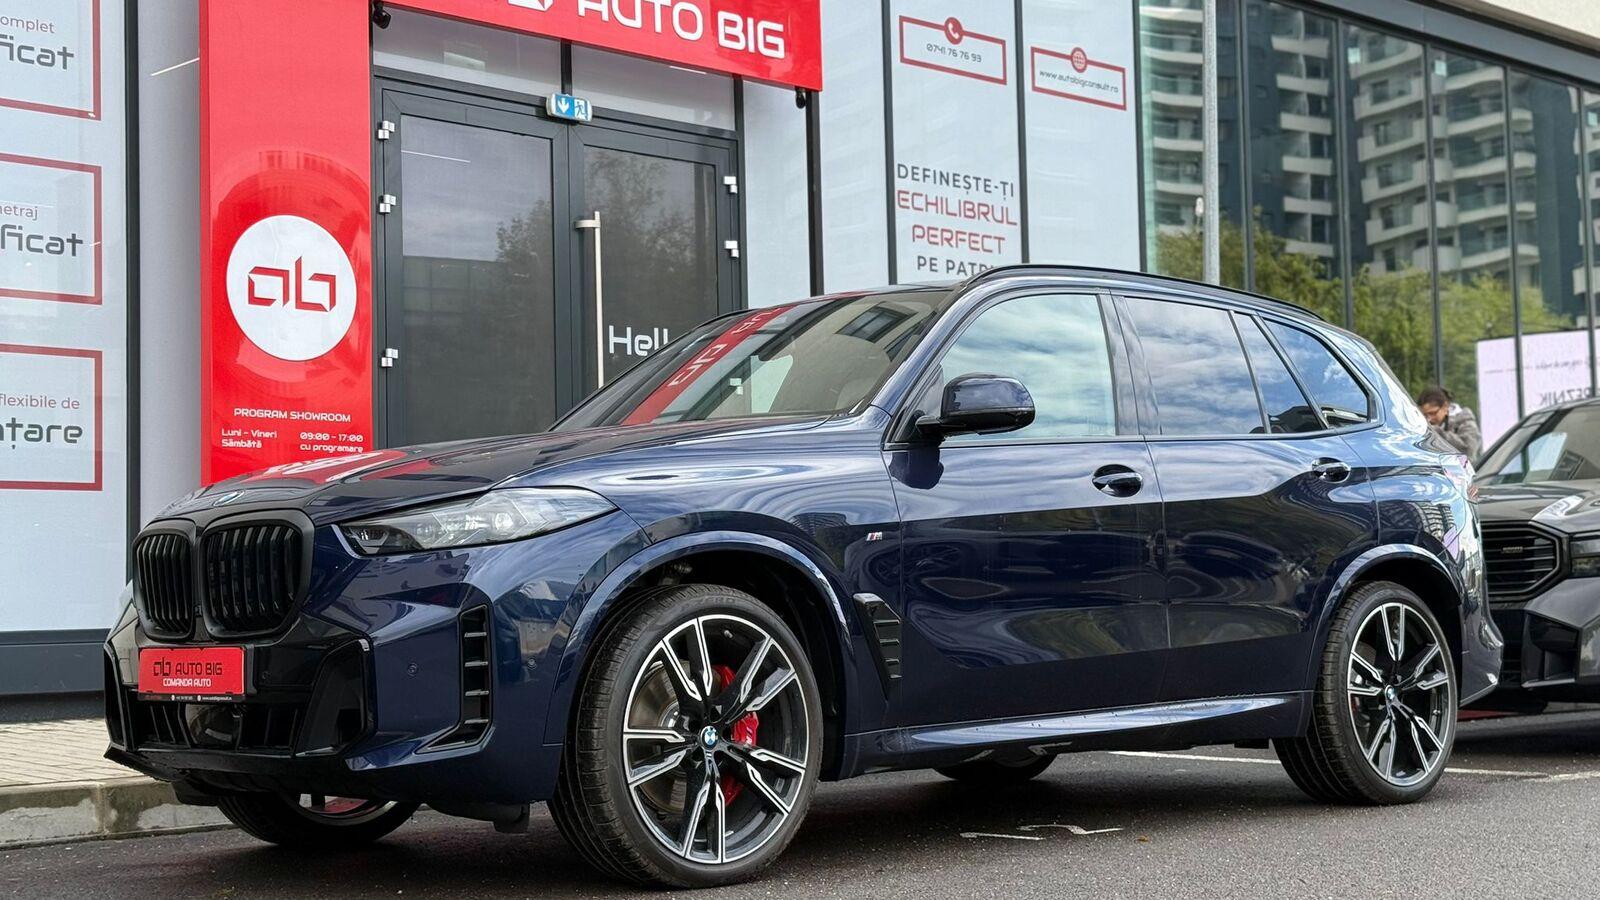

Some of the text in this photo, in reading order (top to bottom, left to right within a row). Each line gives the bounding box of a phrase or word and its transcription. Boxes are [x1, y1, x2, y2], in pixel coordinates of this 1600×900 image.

[717, 11, 785, 59] BIG
[926, 43, 982, 63] 0741 76 76 93
[897, 163, 1014, 200] DEFINEȘTE-ȚI
[897, 190, 1018, 226] ECHILIBRUL
[0, 224, 84, 257] ficat
[912, 224, 1006, 255] PERFECT
[917, 256, 938, 273] PE
[61, 396, 80, 410] de
[234, 408, 351, 422] PROGRAM SHOWROOM
[0, 417, 83, 450] țare
[222, 428, 241, 437] Luni
[251, 429, 277, 438] Vineri
[300, 432, 330, 441] 09:00
[338, 433, 363, 442] 17:00
[300, 443, 311, 451] cu
[312, 444, 363, 454] programare
[175, 663, 202, 675] AUTO
[205, 663, 222, 675] BIG
[163, 678, 211, 687] COMANDA AUTO
